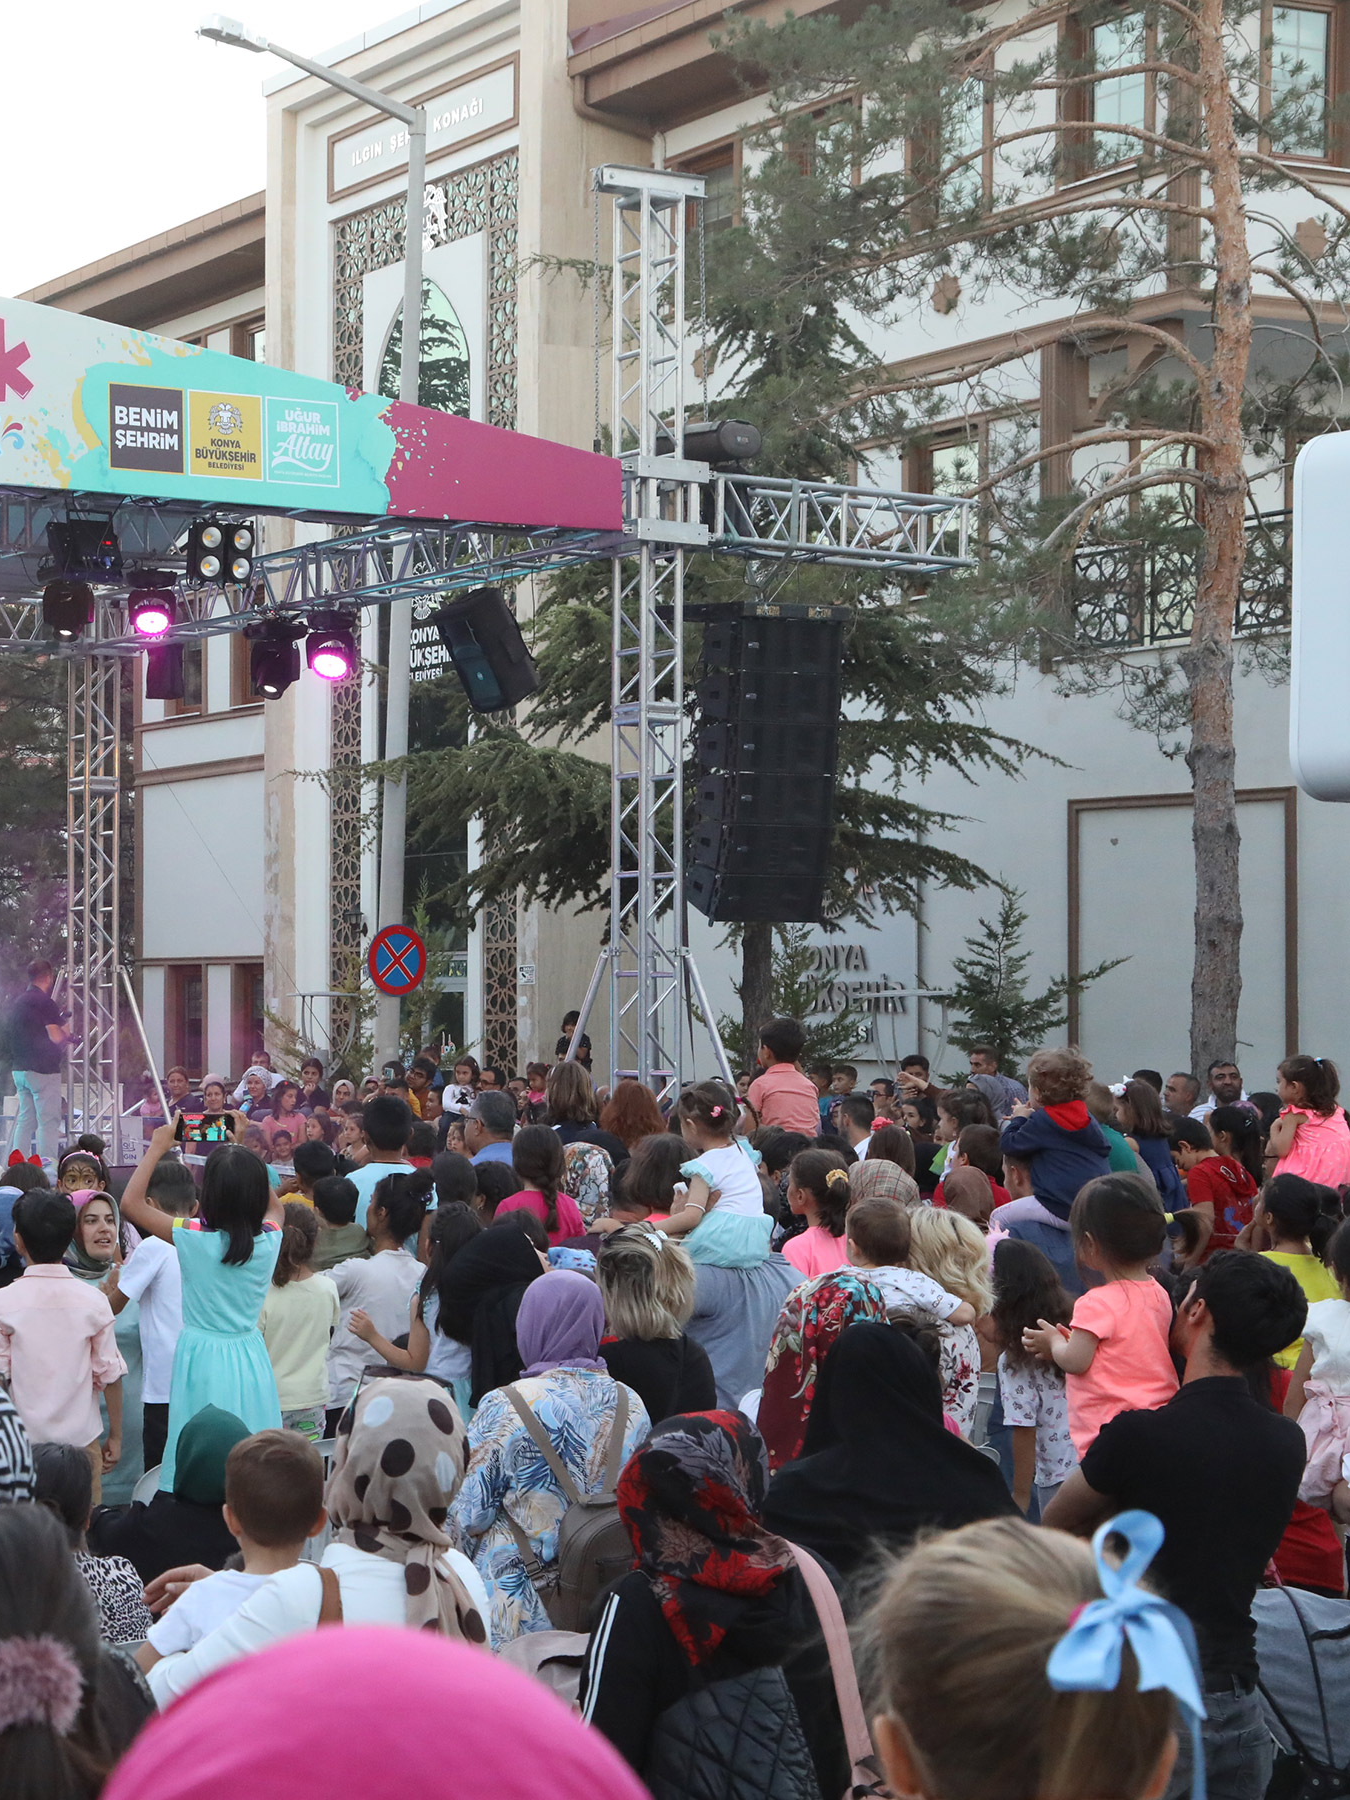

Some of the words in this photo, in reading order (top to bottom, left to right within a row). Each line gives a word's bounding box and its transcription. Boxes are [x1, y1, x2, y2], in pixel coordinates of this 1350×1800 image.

[351, 141, 383, 168] ILGIN
[433, 97, 483, 133] KONAĞI
[114, 405, 179, 430] BENİM
[284, 407, 321, 424] UĞUR
[276, 420, 331, 436] İBRAHİM
[115, 429, 179, 450] ŞEHRİM
[210, 438, 242, 449] KONYA
[195, 446, 257, 464] BÜYÜKŞEHİR
[271, 433, 334, 472] Altay
[207, 461, 245, 471] BELEDİYESİ
[808, 945, 867, 971] ONYA
